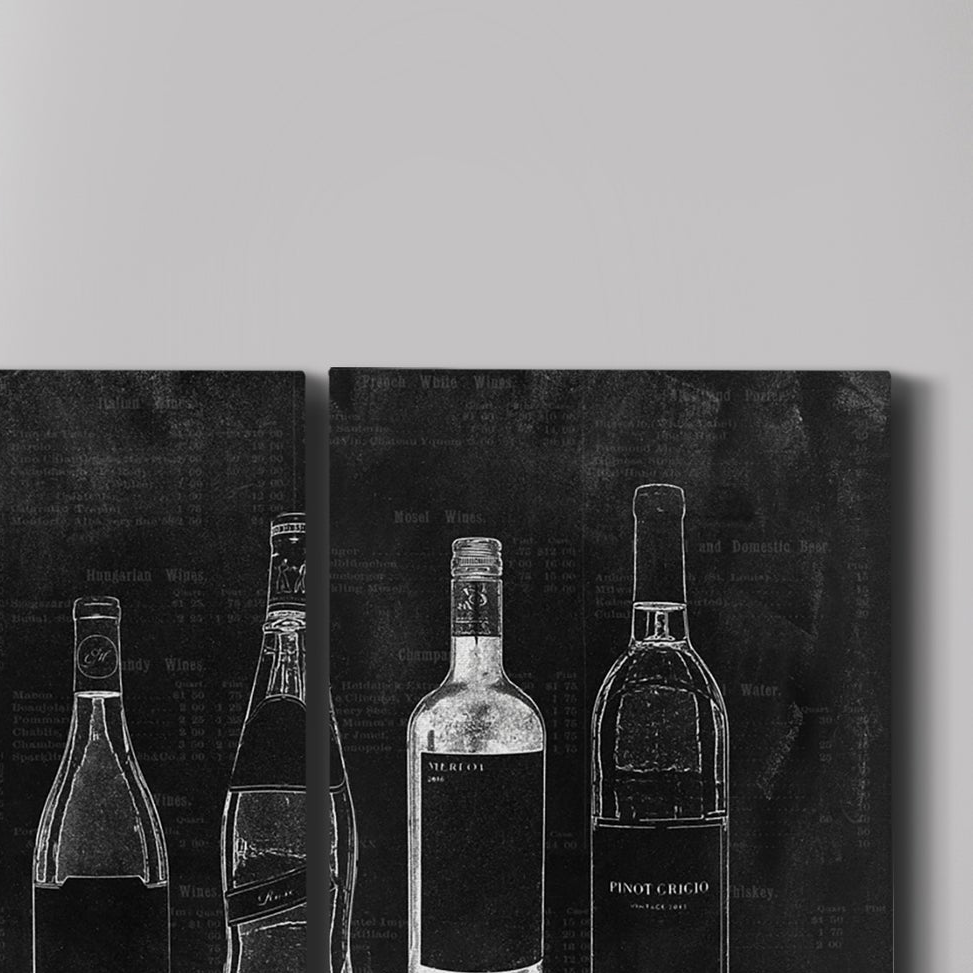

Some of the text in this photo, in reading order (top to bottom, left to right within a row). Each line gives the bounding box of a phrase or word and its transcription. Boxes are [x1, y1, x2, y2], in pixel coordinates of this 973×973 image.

[394, 510, 487, 523] Mosel Wines.
[699, 540, 721, 552] and
[732, 540, 790, 552] Domestic
[87, 567, 208, 582] Hungarian Wines.
[165, 658, 207, 672] Wines.
[741, 684, 781, 697] Water.
[609, 880, 710, 896] PINOT GRIGIO
